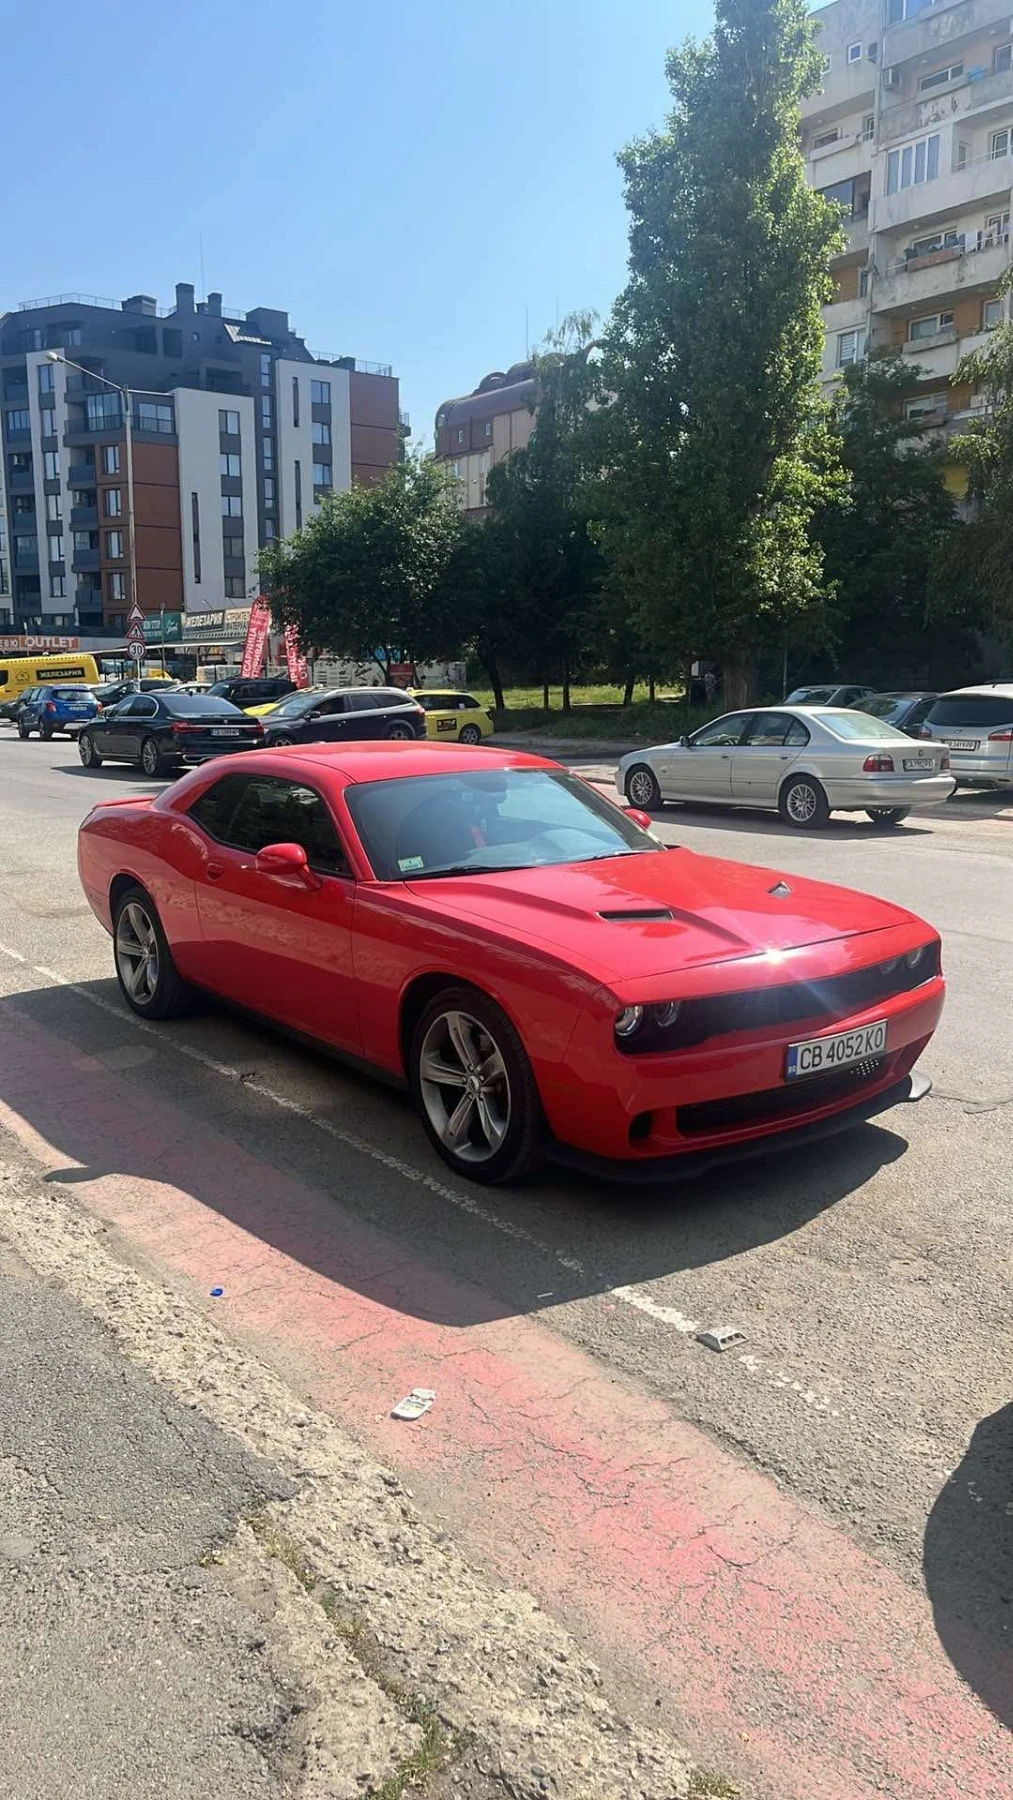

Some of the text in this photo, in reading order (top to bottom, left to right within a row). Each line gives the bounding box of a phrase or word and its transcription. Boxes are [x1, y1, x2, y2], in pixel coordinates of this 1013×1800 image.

[26, 635, 76, 648] OUTLET
[131, 645, 142, 655] 30
[241, 627, 257, 678] ЕСАРНИЦА
[39, 669, 82, 679] ЖЕЛЕЗАРИЯ
[800, 1045, 822, 1070] CB
